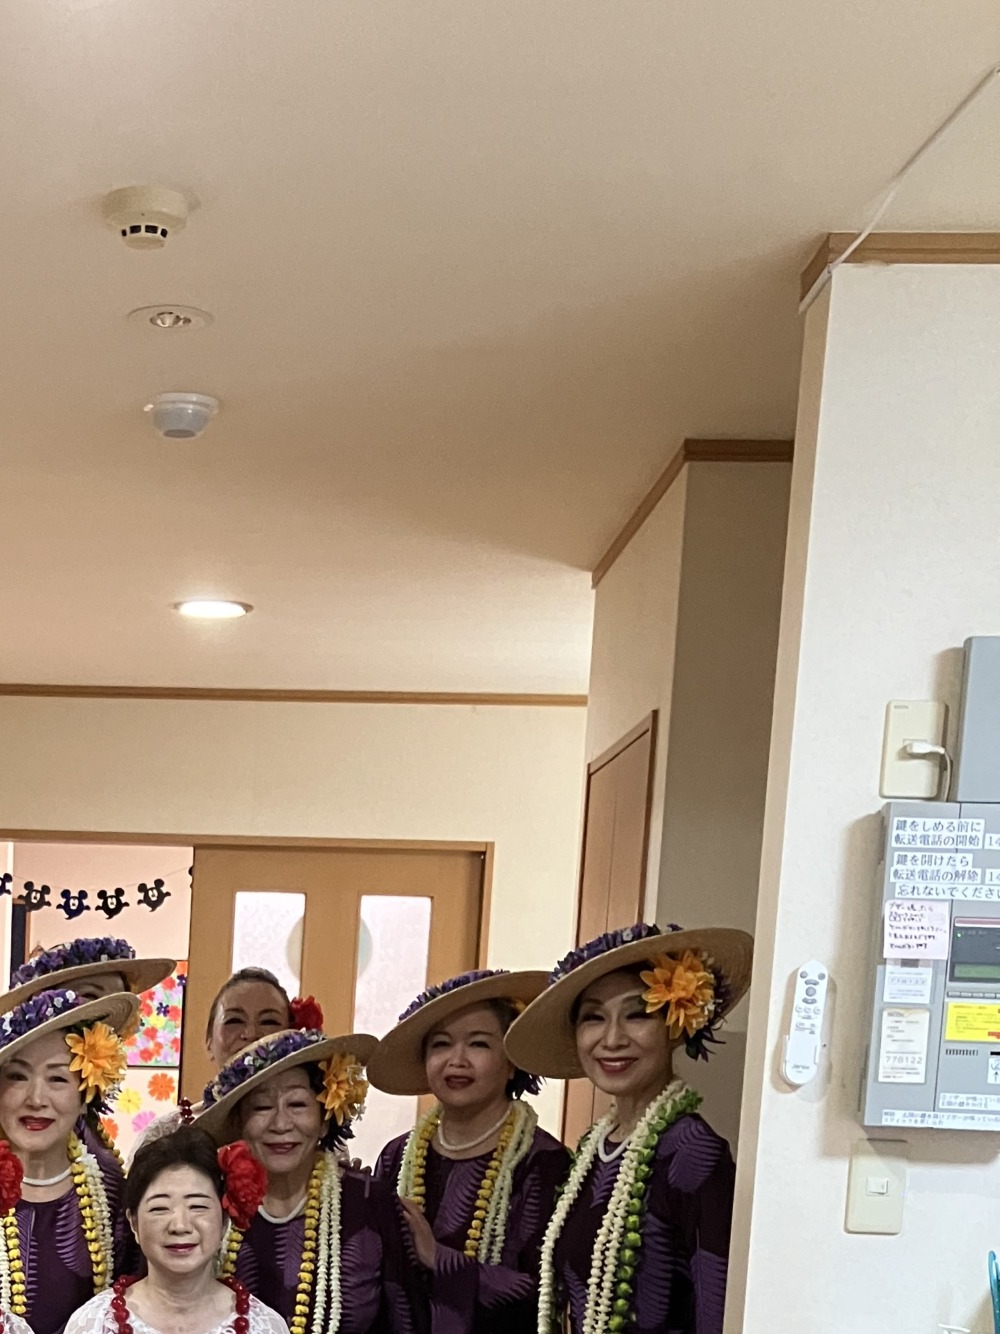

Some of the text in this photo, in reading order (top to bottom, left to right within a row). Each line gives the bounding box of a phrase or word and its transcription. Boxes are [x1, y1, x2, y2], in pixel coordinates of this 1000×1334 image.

[895, 819, 981, 833] 鍵をしめる前に
[894, 833, 980, 847] 転送電話の開始
[895, 854, 970, 868] 鍵を開けたら
[892, 868, 979, 883] 転送電話の解除
